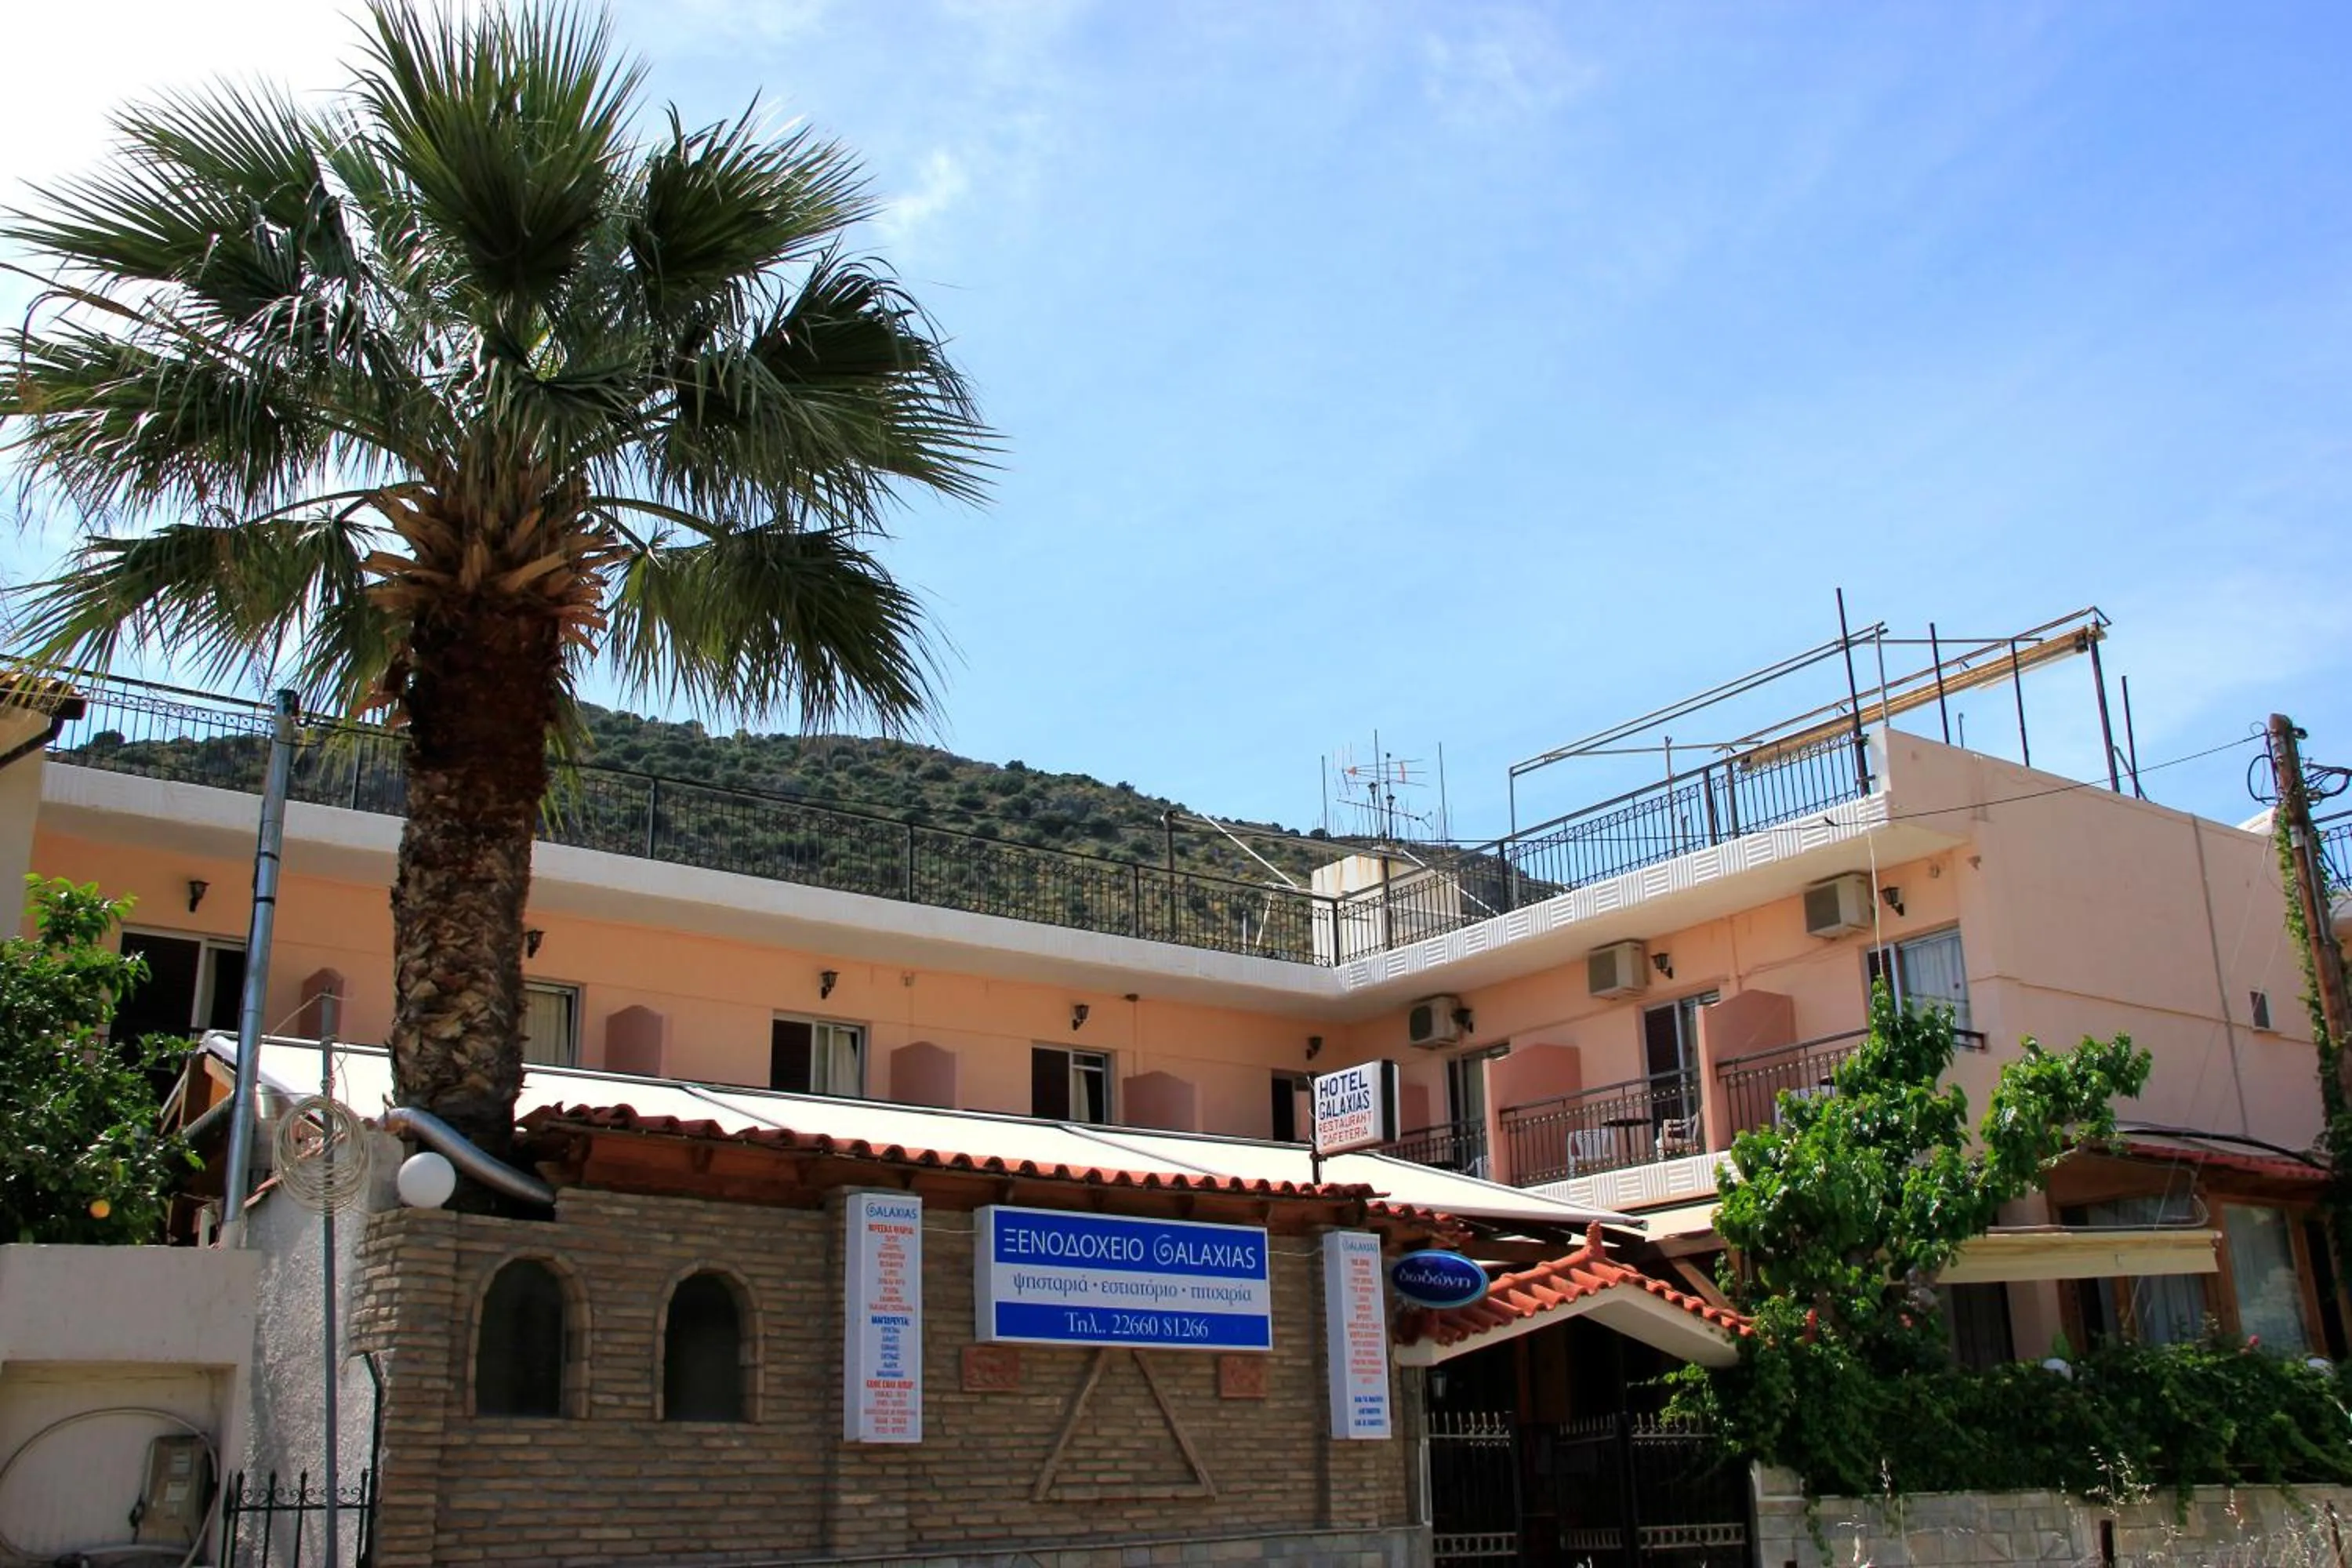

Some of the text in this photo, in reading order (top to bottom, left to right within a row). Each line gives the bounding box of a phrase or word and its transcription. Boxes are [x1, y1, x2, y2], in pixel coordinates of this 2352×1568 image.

[1319, 1069, 1368, 1099] HOTEL
[1319, 1090, 1370, 1120] GALAXIAS
[1323, 1127, 1368, 1146] CAFETERIA
[866, 1202, 917, 1219] GALAXIAS
[1004, 1228, 1256, 1269] ΞΕΝΟΔΟΧΕΙΟ GALAXIAS
[1013, 1272, 1252, 1306] ψησταριά εστιατόριο πιτσαρία
[1112, 1314, 1158, 1336] 22660
[1163, 1316, 1209, 1338] 81266
